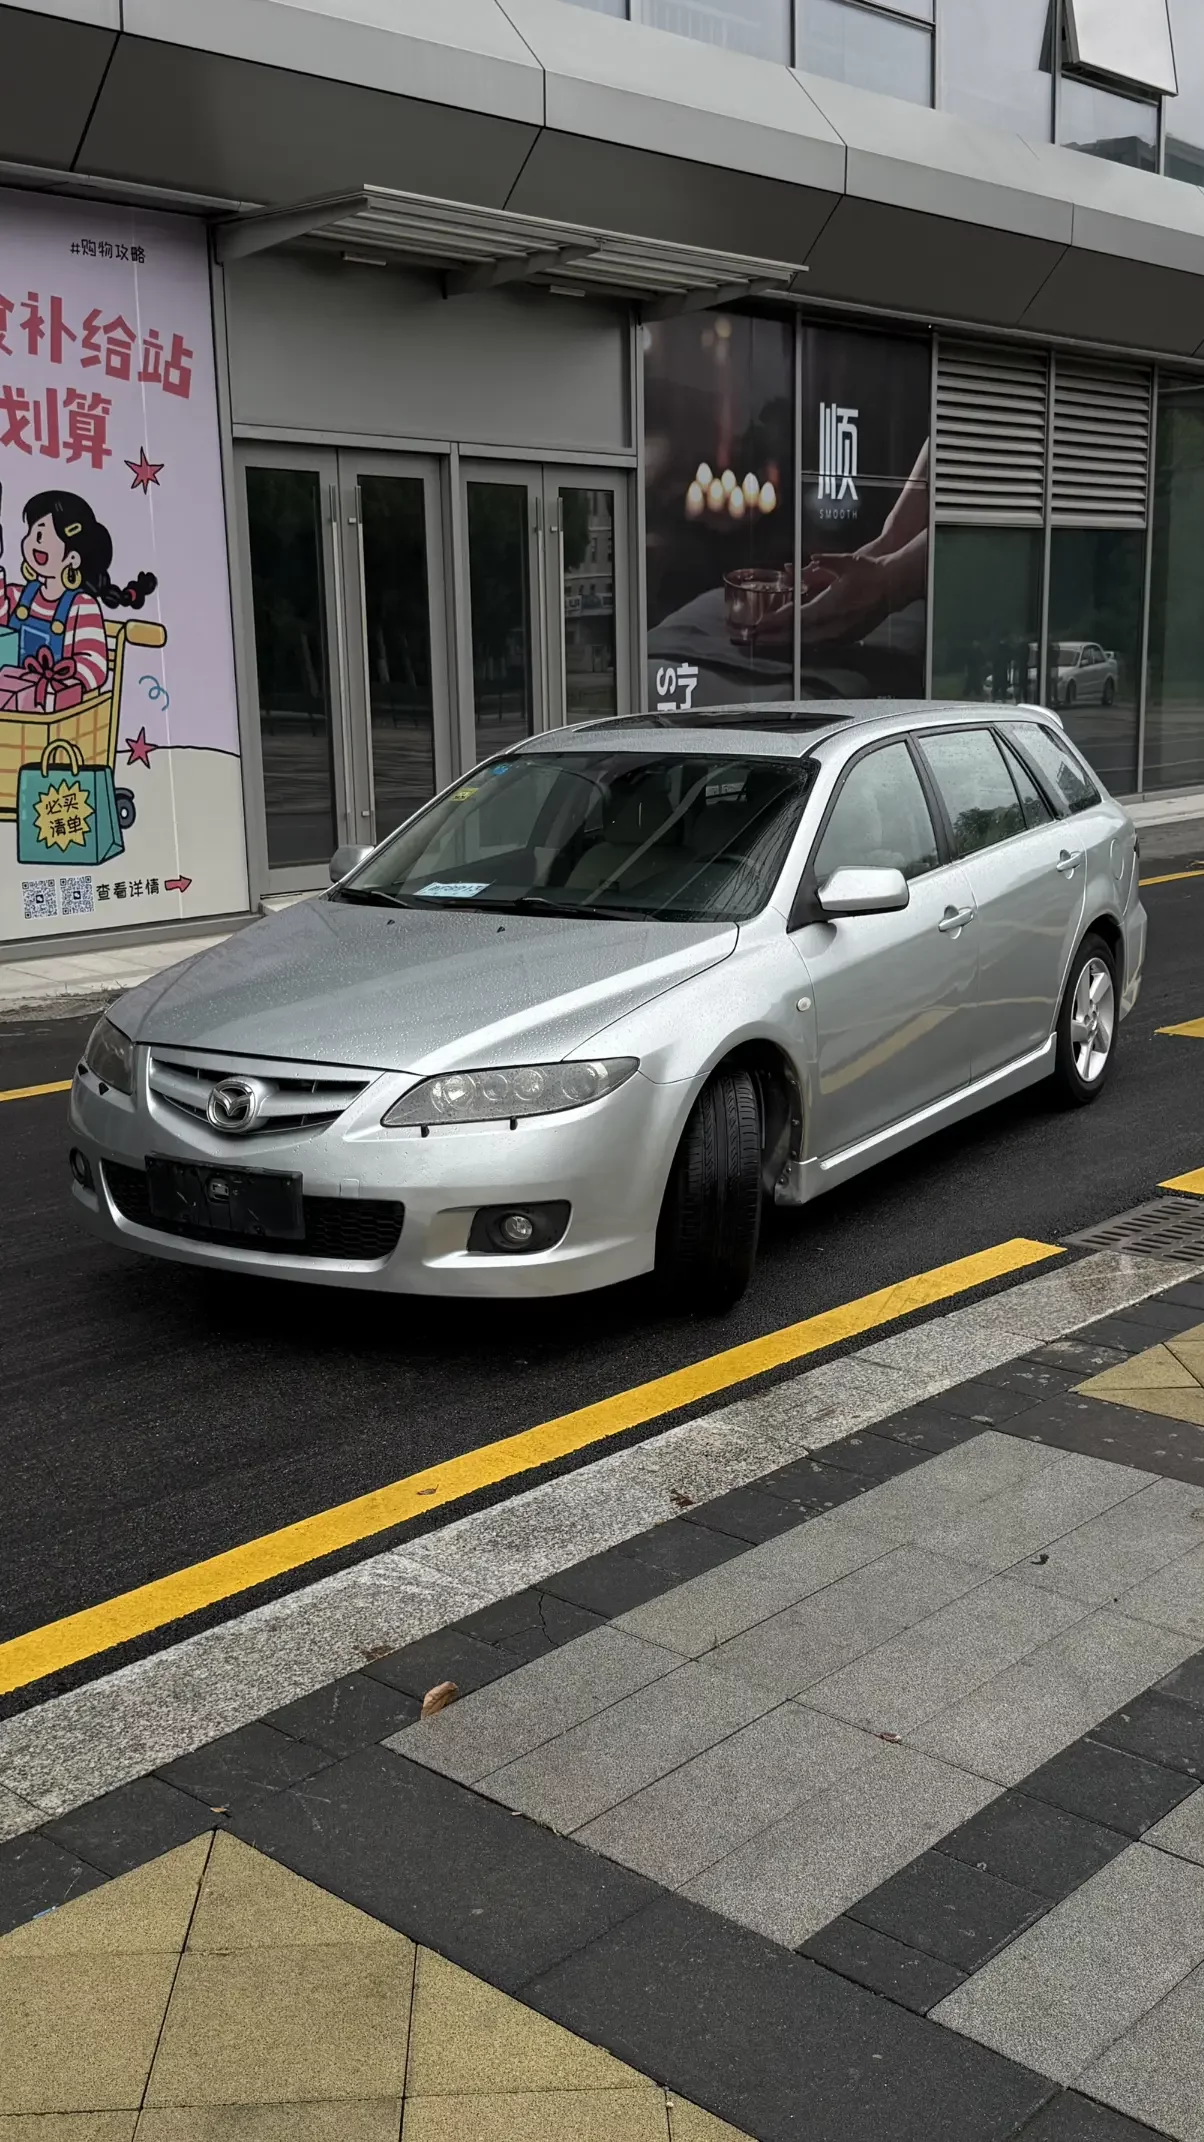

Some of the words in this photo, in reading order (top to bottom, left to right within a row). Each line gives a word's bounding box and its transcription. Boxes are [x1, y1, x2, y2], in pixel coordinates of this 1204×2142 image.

[70, 239, 145, 263] #购物攻略
[0, 291, 193, 399] 补给站
[819, 509, 857, 519] SMOOTH
[46, 793, 79, 815] 必买
[50, 815, 83, 838] 清单
[96, 878, 159, 901] 查看详情
